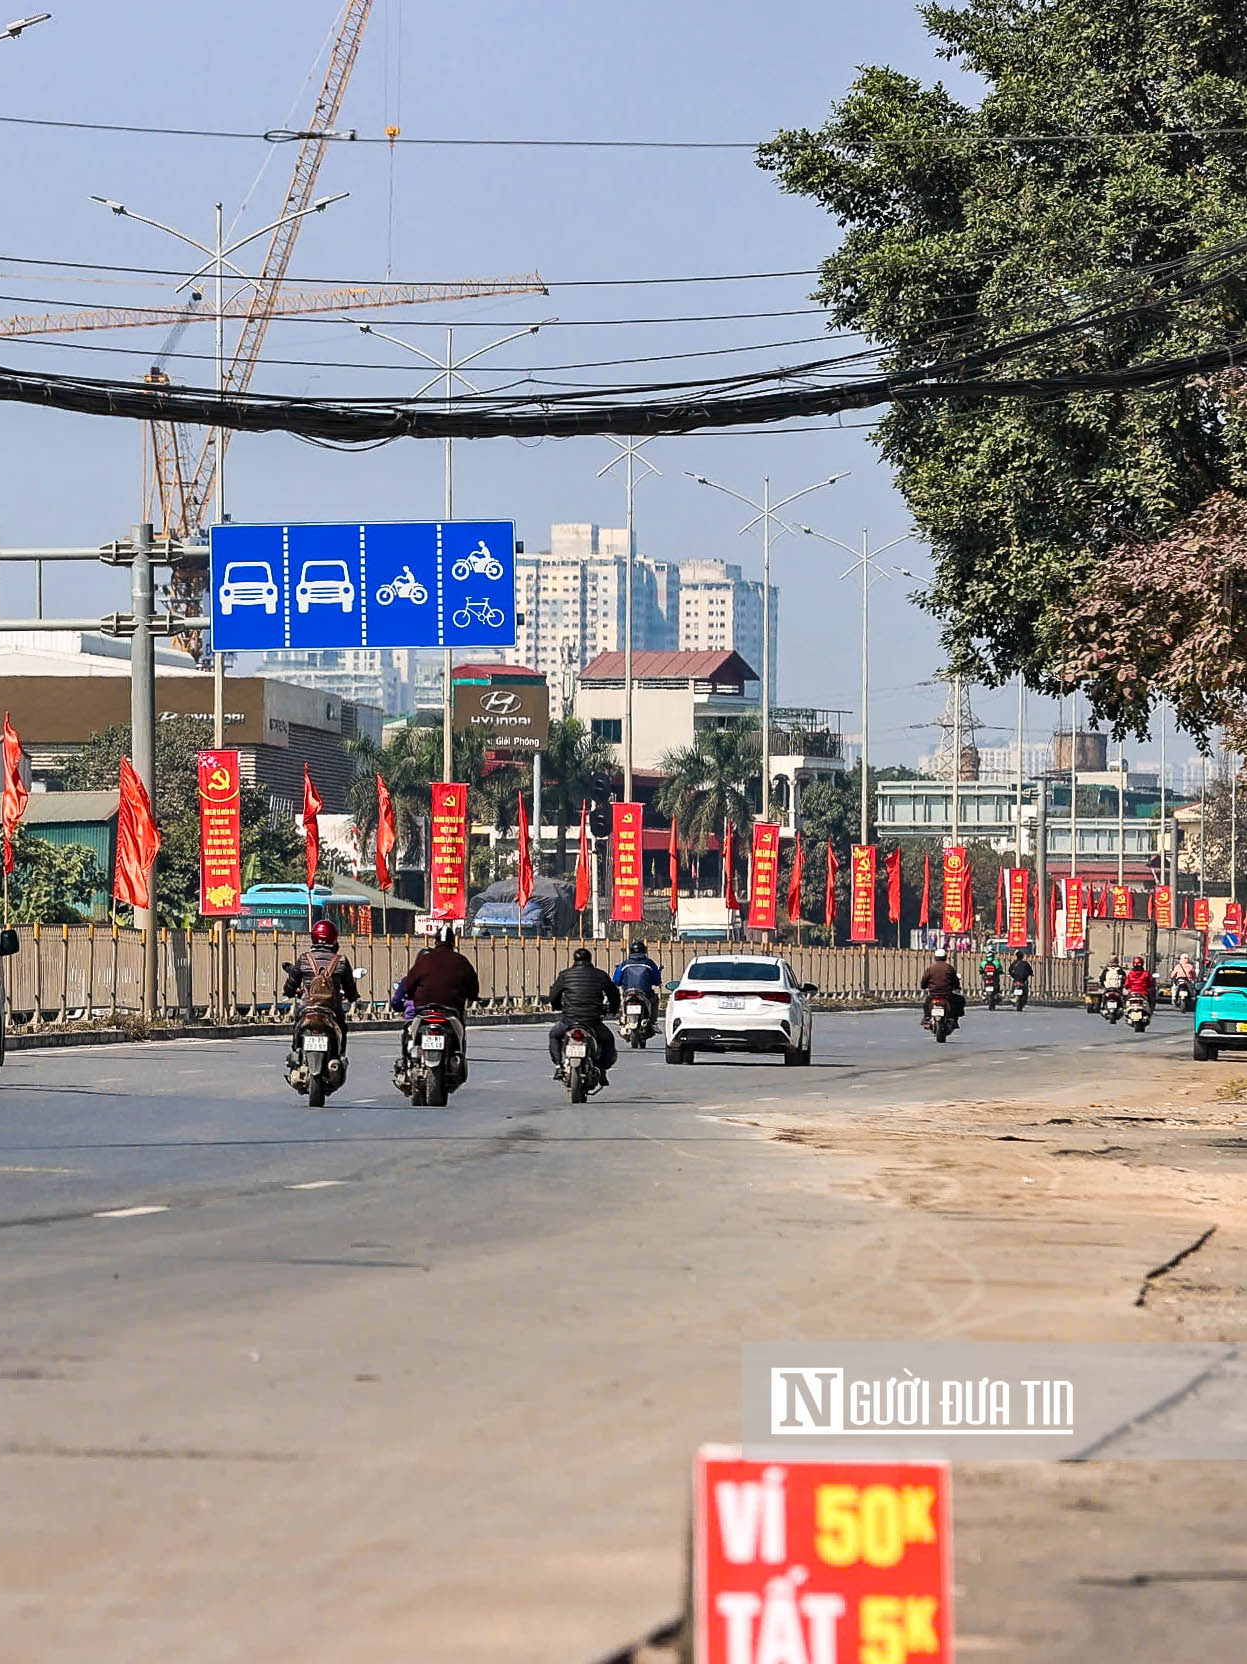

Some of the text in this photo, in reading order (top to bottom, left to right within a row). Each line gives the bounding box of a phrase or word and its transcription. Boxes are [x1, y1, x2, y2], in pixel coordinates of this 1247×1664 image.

[715, 1466, 936, 1568] VÍ 50K
[858, 1594, 940, 1664] 5K
